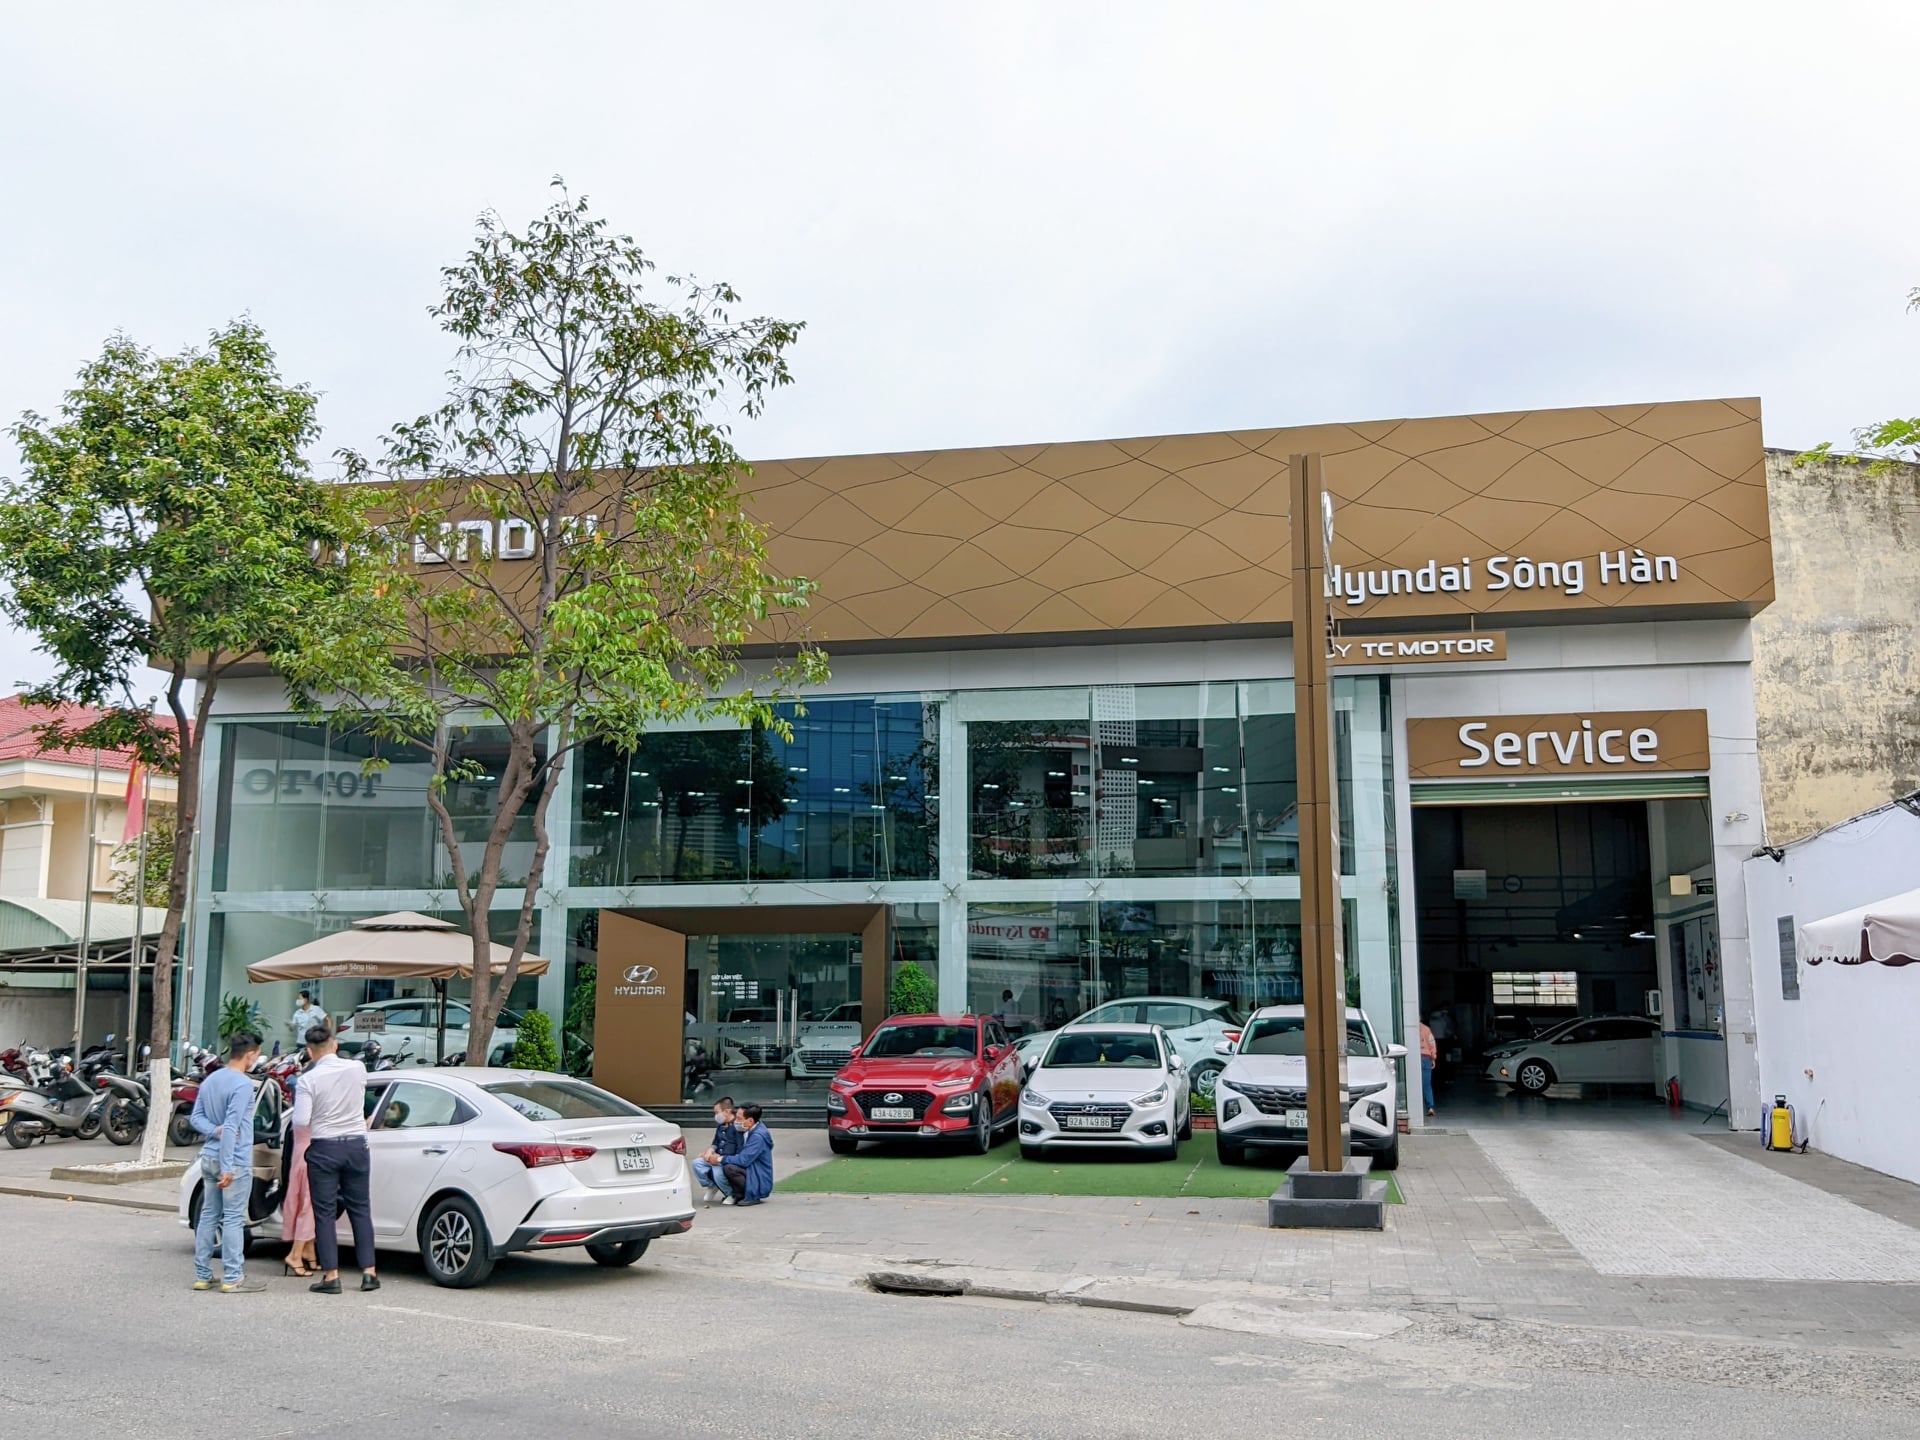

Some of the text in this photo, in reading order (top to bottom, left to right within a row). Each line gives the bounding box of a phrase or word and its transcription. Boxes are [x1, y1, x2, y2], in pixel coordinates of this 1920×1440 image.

[1486, 556, 1585, 595] Sông
[1600, 549, 1678, 584] Hàn
[1335, 643, 1352, 658] Y
[1458, 719, 1659, 767] Service
[614, 985, 666, 996] HYUNDAI
[1295, 1111, 1307, 1119] 43
